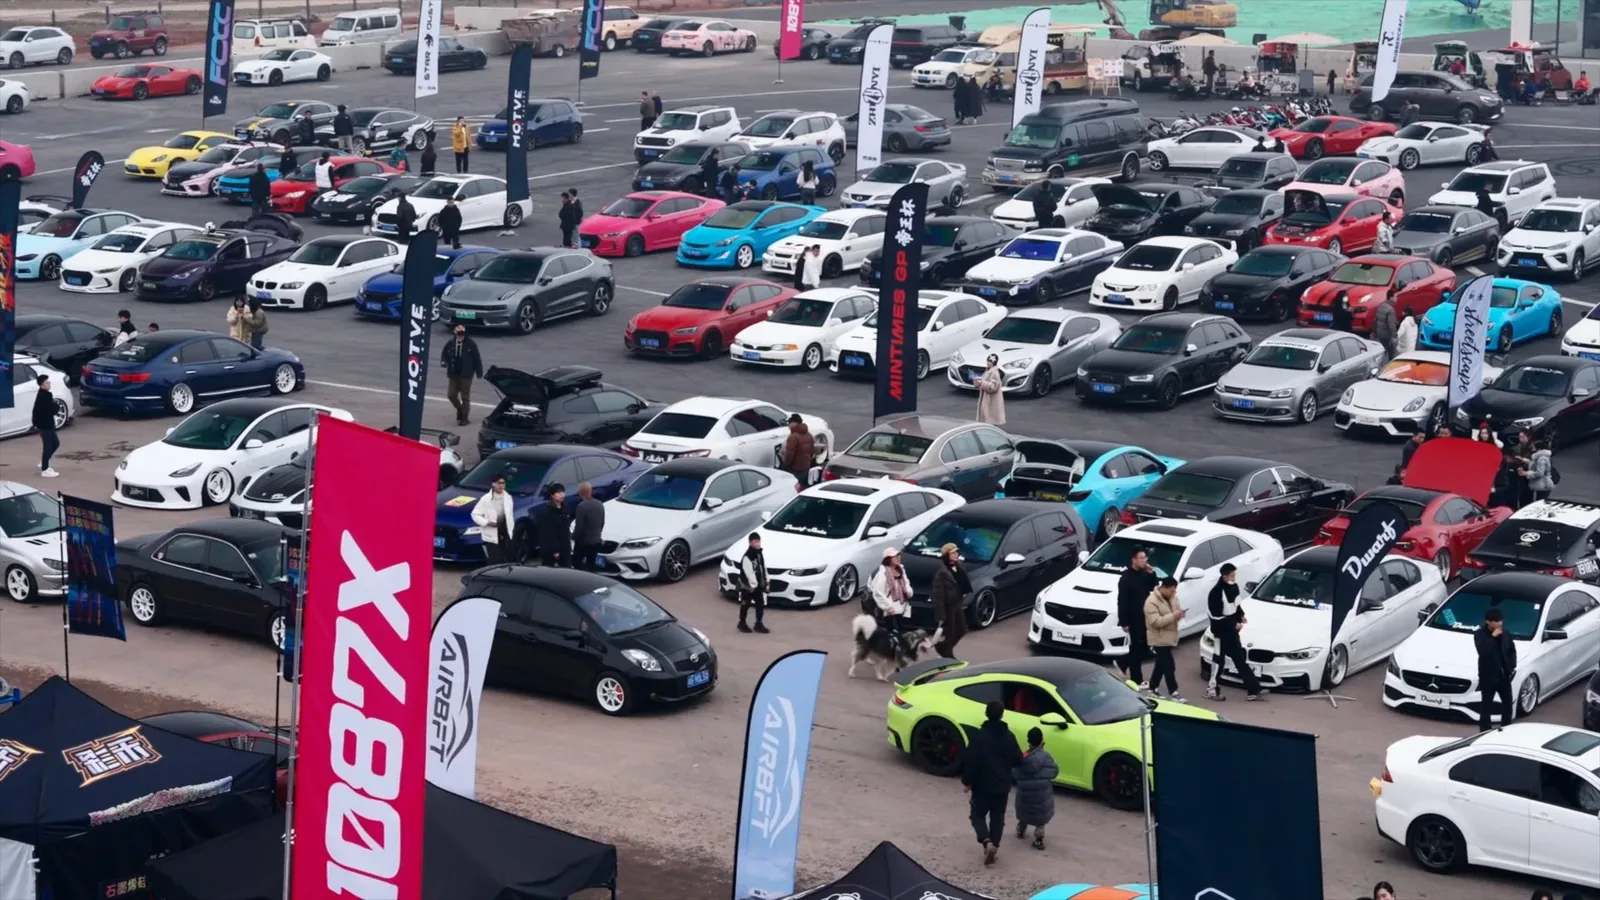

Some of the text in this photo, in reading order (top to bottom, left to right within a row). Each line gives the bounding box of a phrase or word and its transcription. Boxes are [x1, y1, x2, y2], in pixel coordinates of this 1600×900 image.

[895, 199, 916, 247] 帝王杯
[889, 250, 909, 402] MINTIMES GP
[1459, 305, 1484, 394] streetscape
[1341, 518, 1397, 580] Dwarf
[325, 529, 411, 900] 1087X
[429, 637, 457, 764] AIRBFT
[751, 702, 783, 839] AIRBFT
